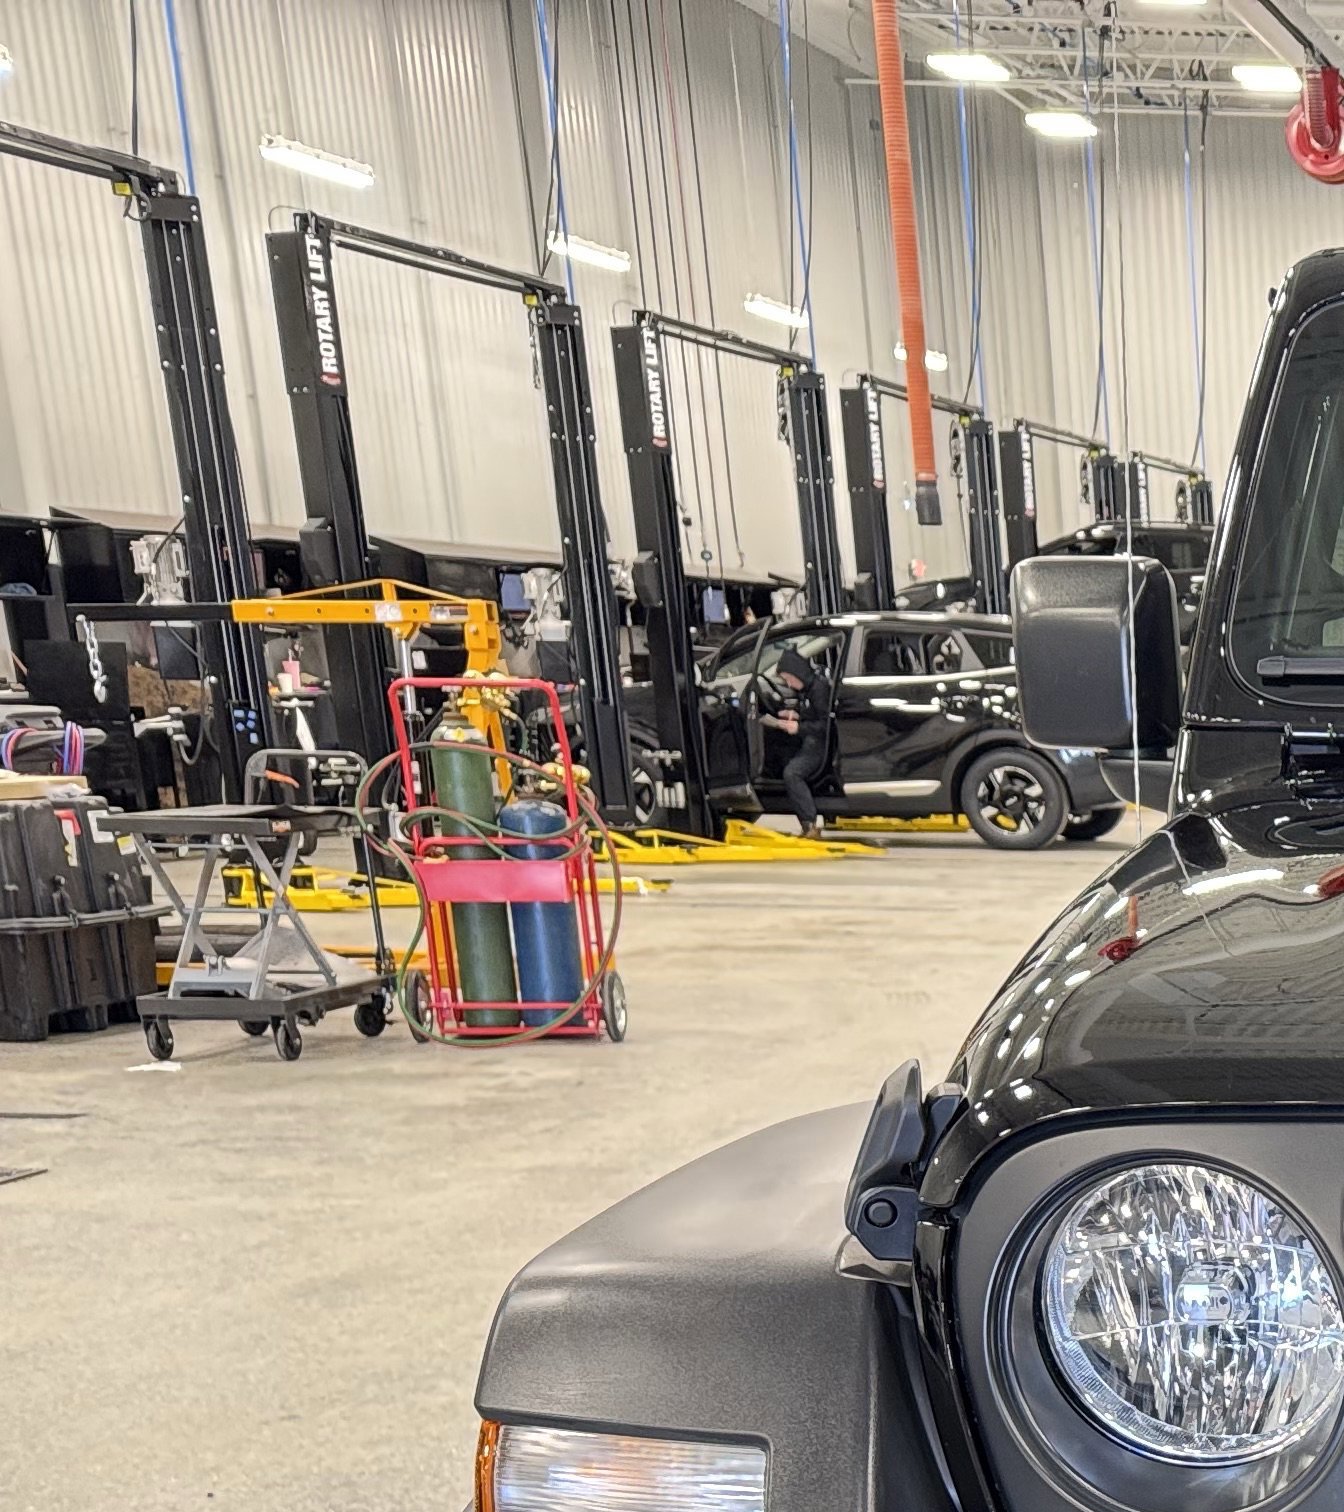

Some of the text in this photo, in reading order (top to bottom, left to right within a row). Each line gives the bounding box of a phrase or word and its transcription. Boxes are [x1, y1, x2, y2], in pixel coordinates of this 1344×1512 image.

[304, 234, 340, 374] ROTARY LIFT
[642, 327, 667, 438] ROTARY LIFT
